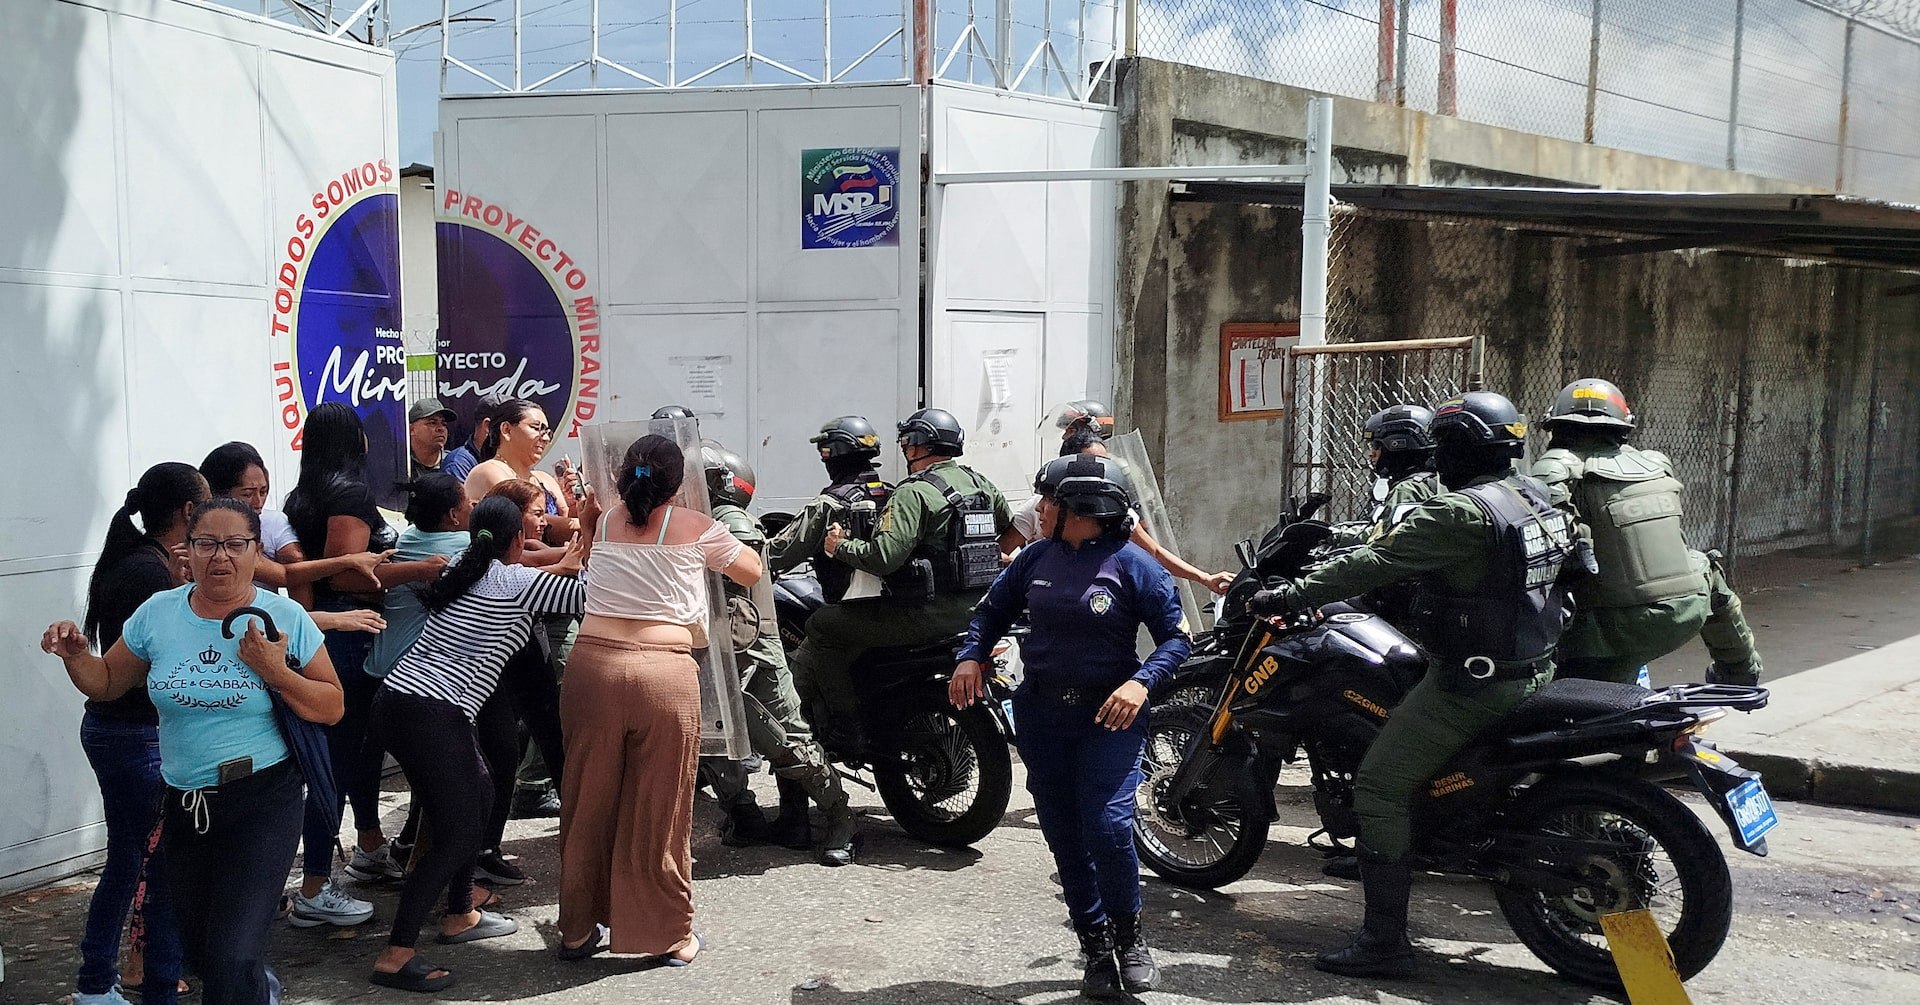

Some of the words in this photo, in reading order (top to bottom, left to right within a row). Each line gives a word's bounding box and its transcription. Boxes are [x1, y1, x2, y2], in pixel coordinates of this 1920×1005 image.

[806, 150, 841, 180] Ministerio
[813, 192, 874, 216] MSP
[272, 213, 314, 337] TODOS
[312, 158, 393, 219] SOMOS
[444, 189, 587, 291] PROYECTO
[375, 327, 400, 339] Hecho
[1572, 388, 1608, 401] GNB
[1622, 495, 1676, 518] GNB
[1523, 515, 1567, 541] GUADIA
[150, 679, 187, 691] DOLCE
[1244, 655, 1280, 695] GNB
